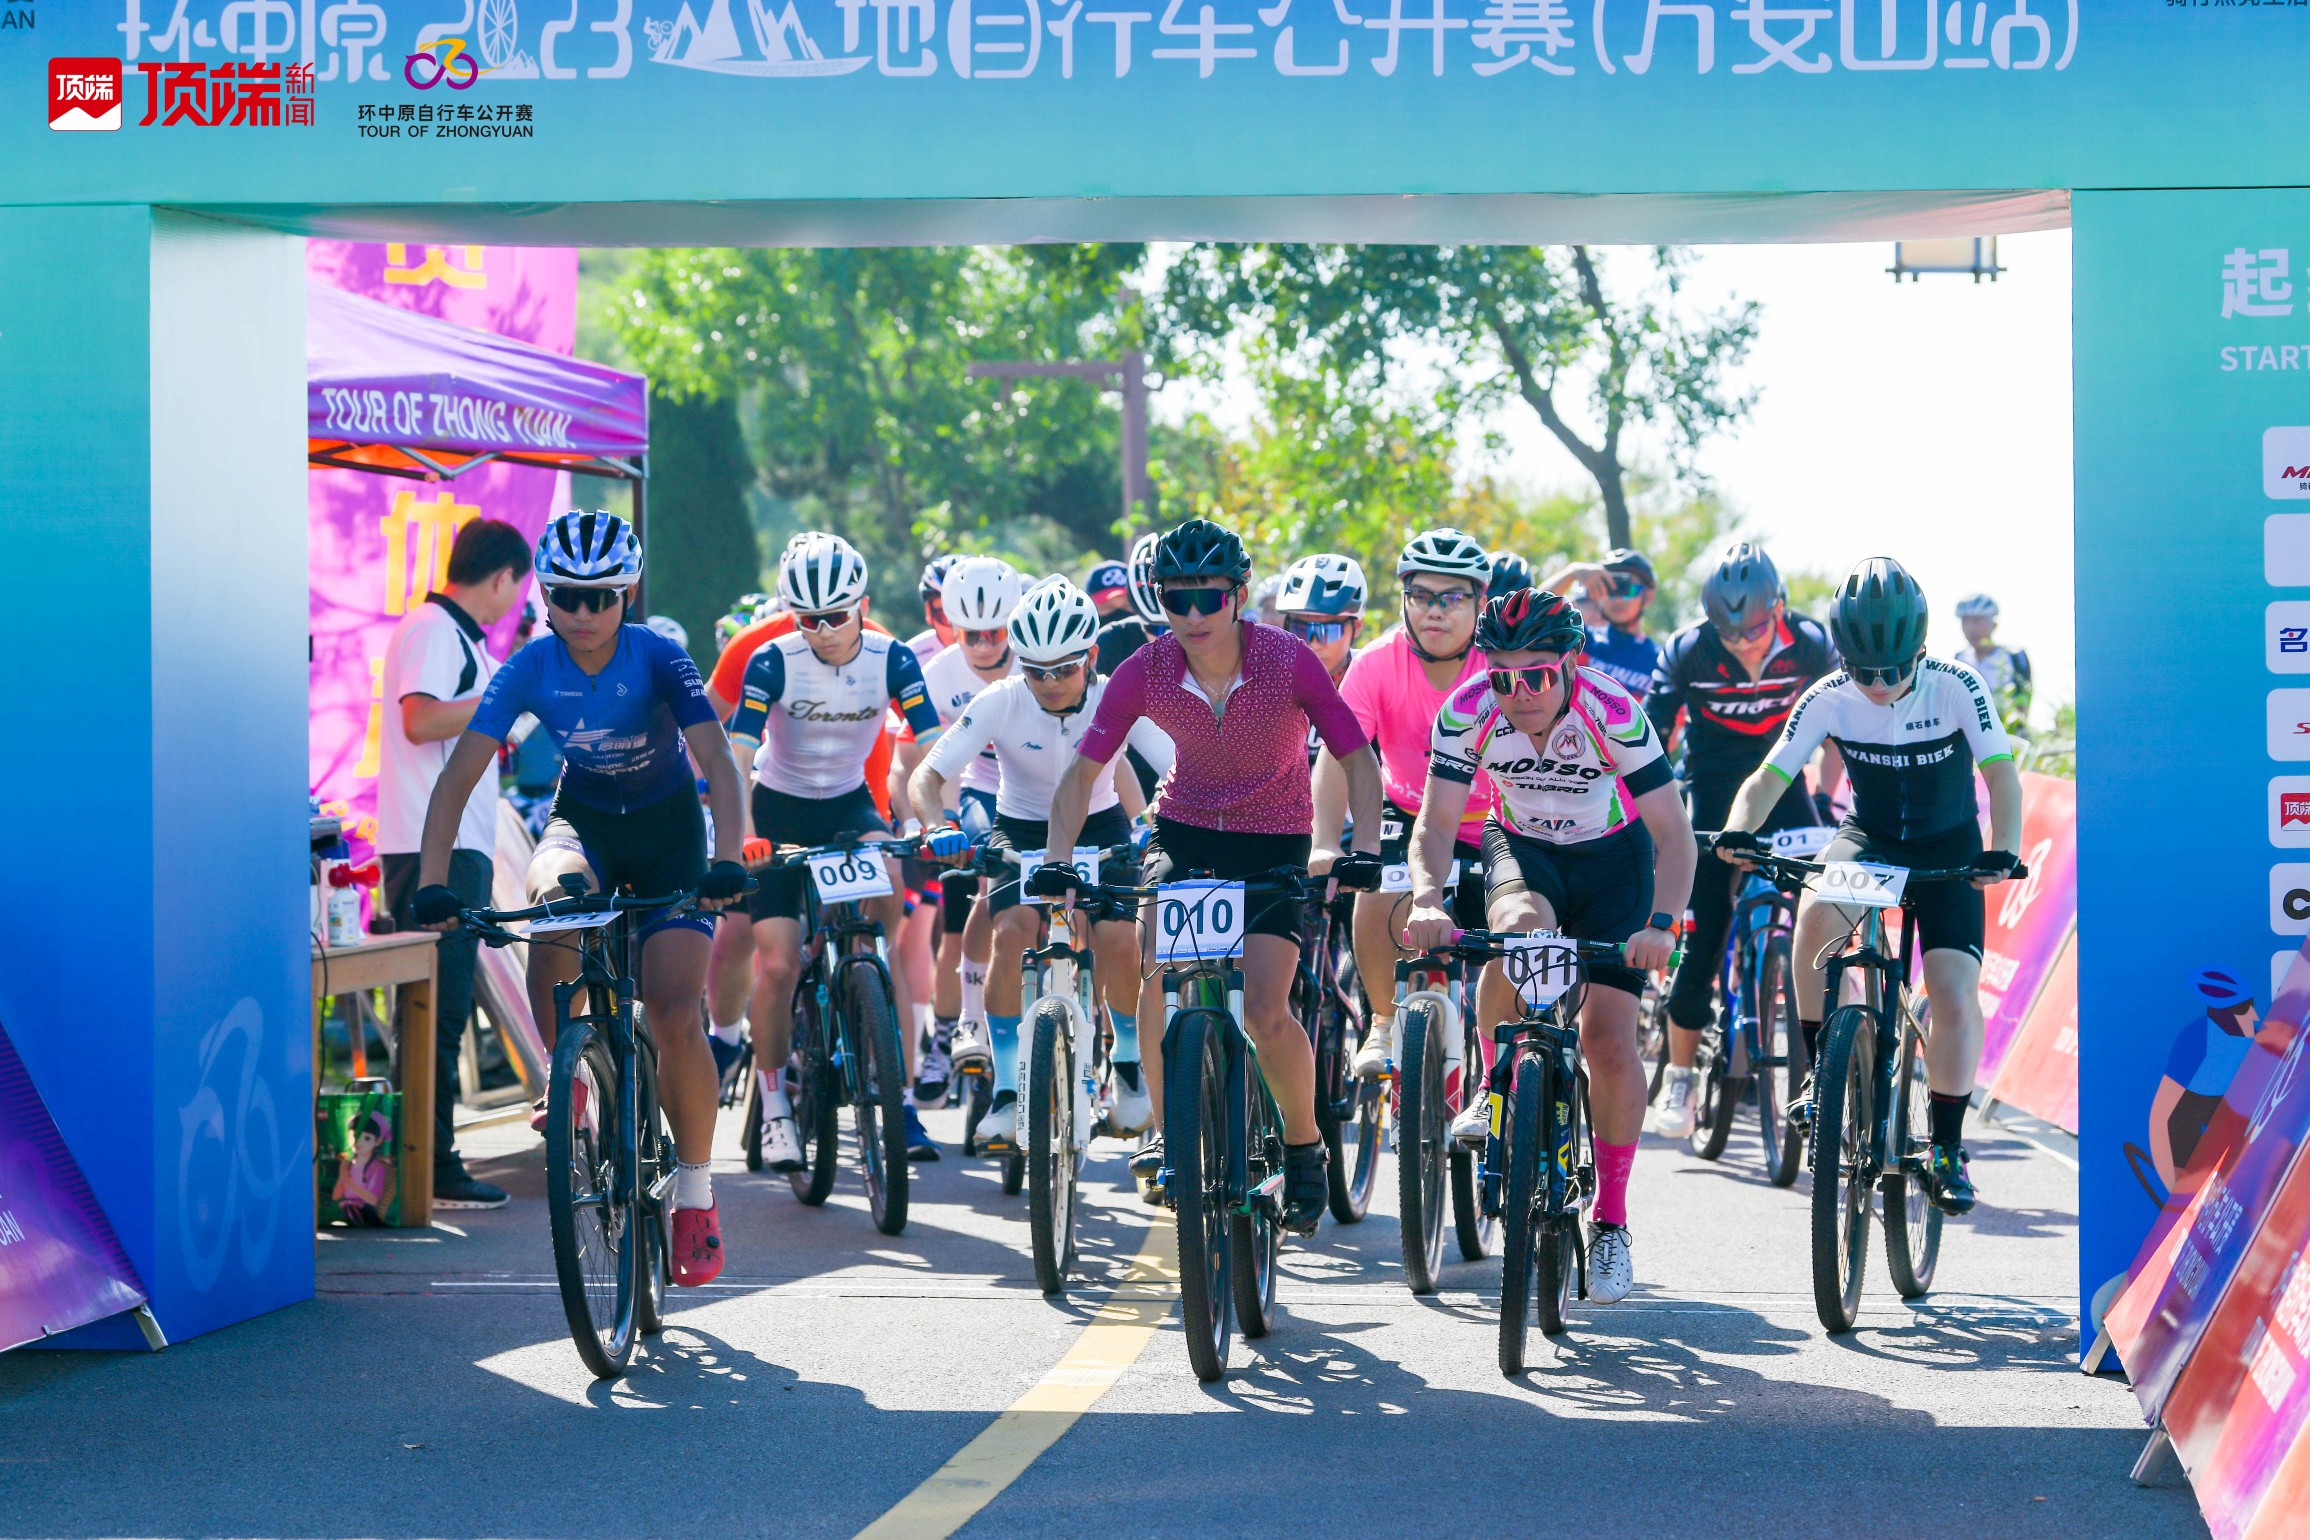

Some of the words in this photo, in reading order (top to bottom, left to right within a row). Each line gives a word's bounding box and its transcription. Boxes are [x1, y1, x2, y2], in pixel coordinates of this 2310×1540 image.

[2220, 247, 2310, 320] 起
[321, 387, 390, 434] TOUR
[393, 391, 423, 435] OF
[429, 394, 513, 443] ZHONG
[1591, 686, 1626, 715] MOSSO
[1926, 659, 1981, 693] WANSHI
[1974, 696, 1993, 732] BIEK
[787, 699, 882, 723] Toronto
[1486, 758, 1602, 780] MOSSO
[1845, 748, 1909, 767] WANSHI
[1917, 745, 1954, 766] BIEK
[1515, 783, 1590, 794] TUBRO
[819, 861, 876, 885] 009
[1826, 869, 1895, 891] 007
[1164, 898, 1233, 936] 010
[1509, 946, 1571, 985] 011
